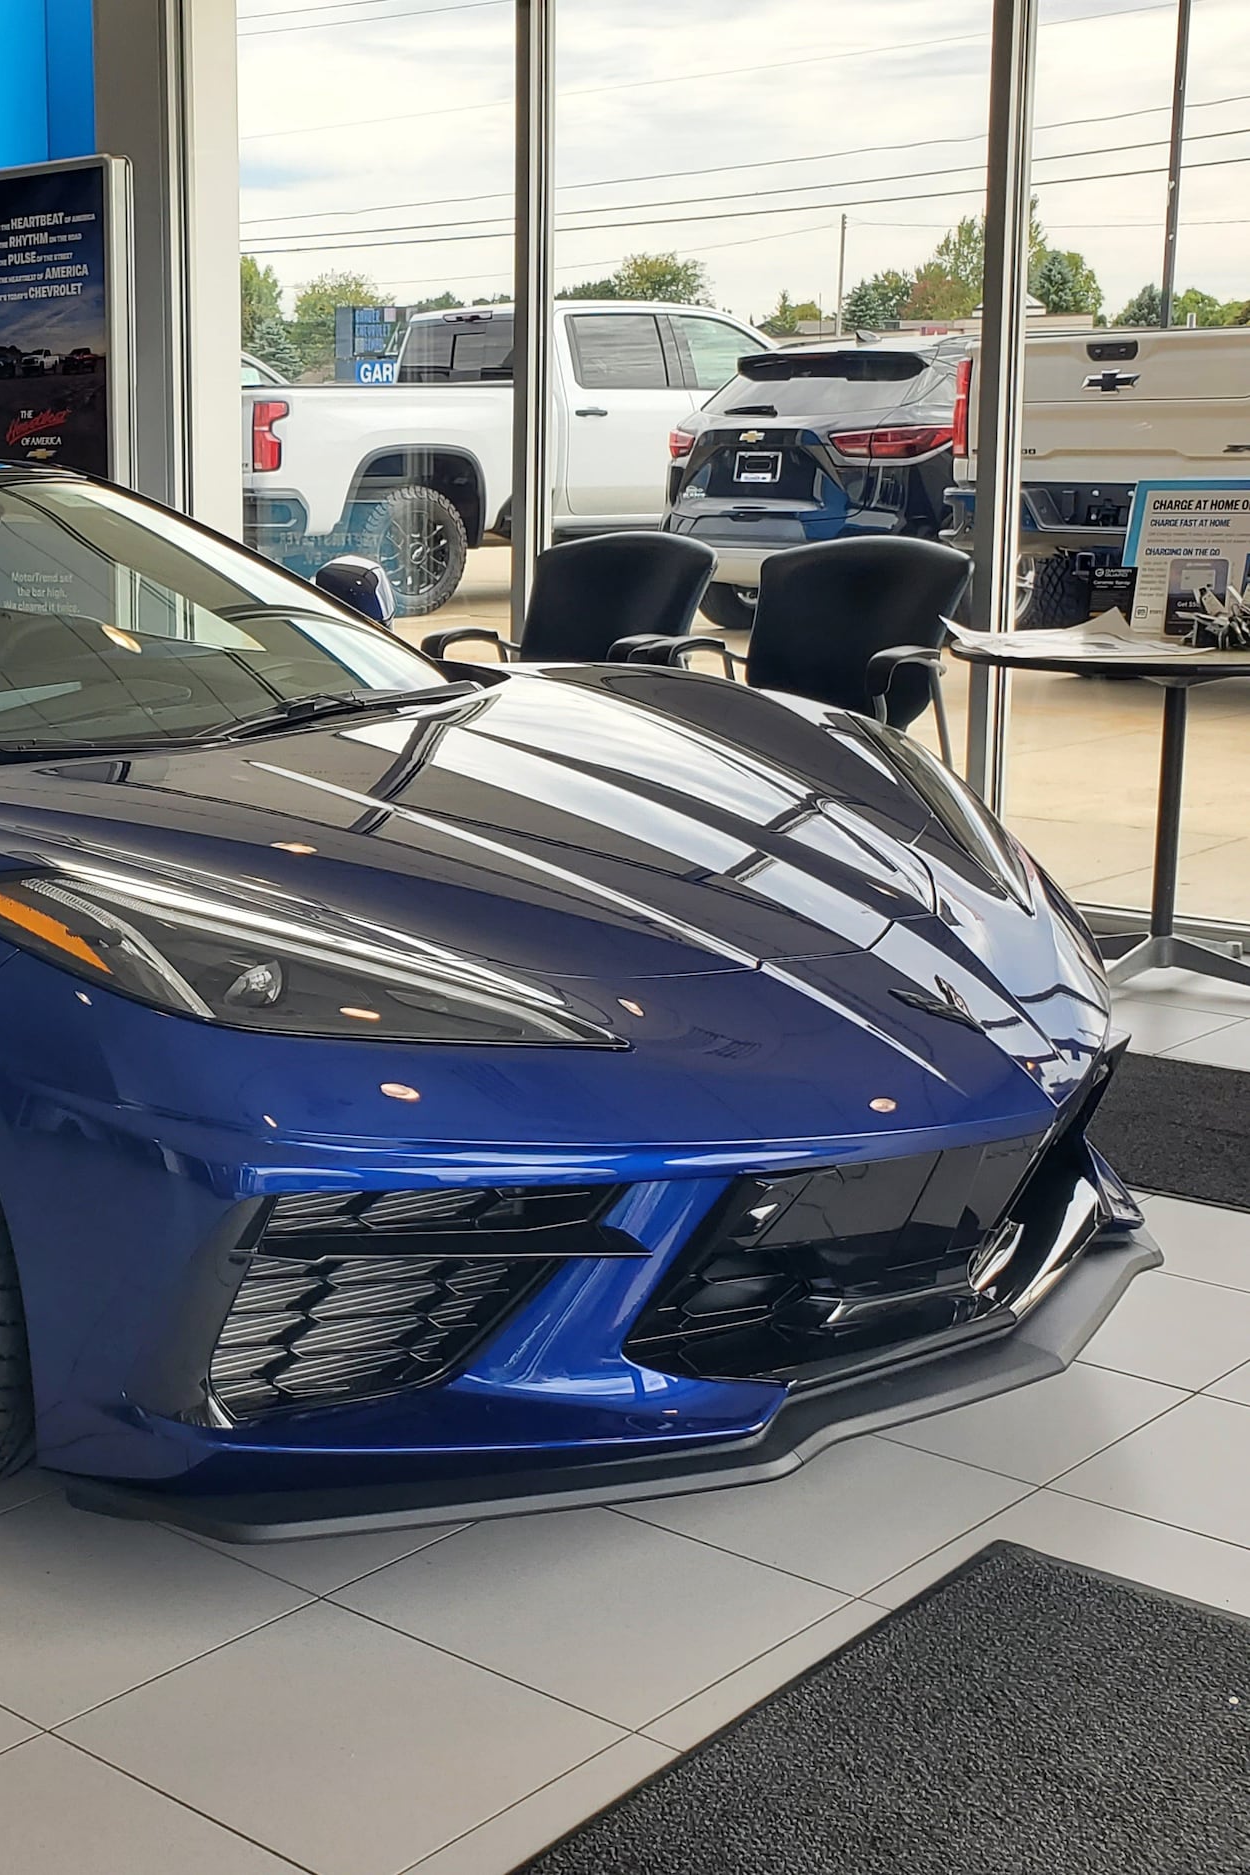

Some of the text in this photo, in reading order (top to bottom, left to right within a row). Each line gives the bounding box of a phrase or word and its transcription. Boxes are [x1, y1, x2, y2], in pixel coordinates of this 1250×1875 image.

[10, 212, 65, 230] HEARTBEAT
[9, 232, 49, 248] RHYTHM
[7, 251, 37, 266] PULSE
[45, 264, 89, 280] AMERICA
[28, 282, 83, 299] CHEVROLET
[360, 363, 396, 383] GAR
[20, 410, 34, 419] THE
[21, 436, 62, 446] OF AMERICA
[1153, 499, 1250, 511] CHARGE AT HOME O
[1150, 519, 1231, 528] CHARGE FAST AT HOME
[1145, 547, 1220, 556] CHARGING ON THE GO
[11, 572, 58, 582] MotorTrend
[17, 587, 30, 597] the
[31, 586, 46, 597] bar
